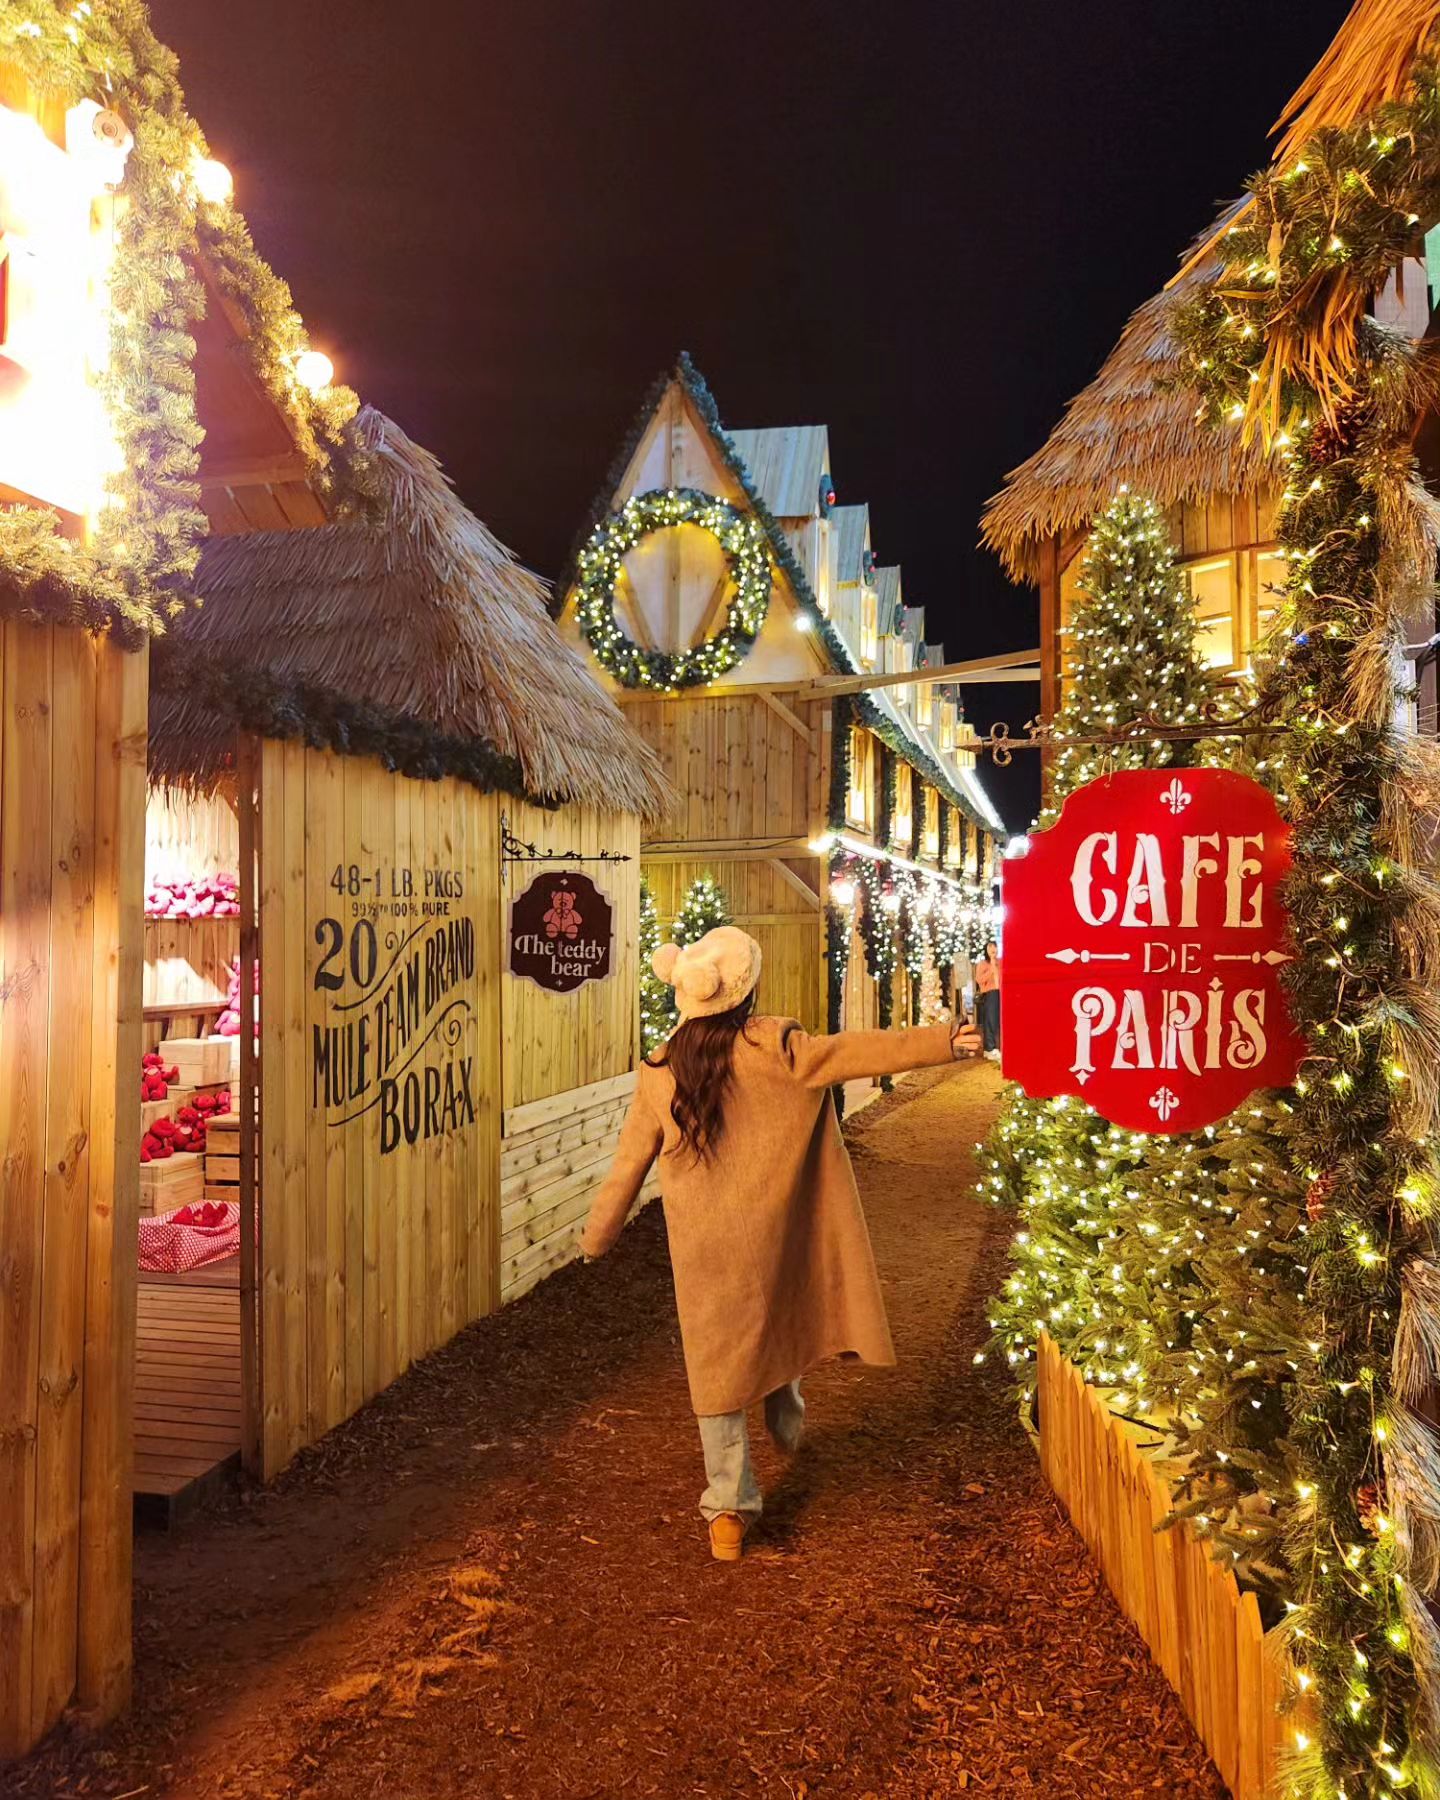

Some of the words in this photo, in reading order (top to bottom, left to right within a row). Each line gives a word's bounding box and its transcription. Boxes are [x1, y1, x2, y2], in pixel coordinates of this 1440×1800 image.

[391, 867, 418, 898] LB.
[424, 868, 463, 899] PKGS
[1070, 831, 1265, 928] CAFE
[422, 901, 450, 916] PURE
[314, 917, 378, 991] 20
[514, 933, 555, 956] The
[558, 939, 607, 965] teddy
[551, 955, 592, 977] bear
[1143, 942, 1202, 974] DE
[312, 1013, 371, 1109] MULE
[375, 951, 420, 1082] TEAM
[424, 916, 475, 1017] BRAND
[1069, 976, 1267, 1086] PARIS
[379, 1056, 476, 1155] BORAX
